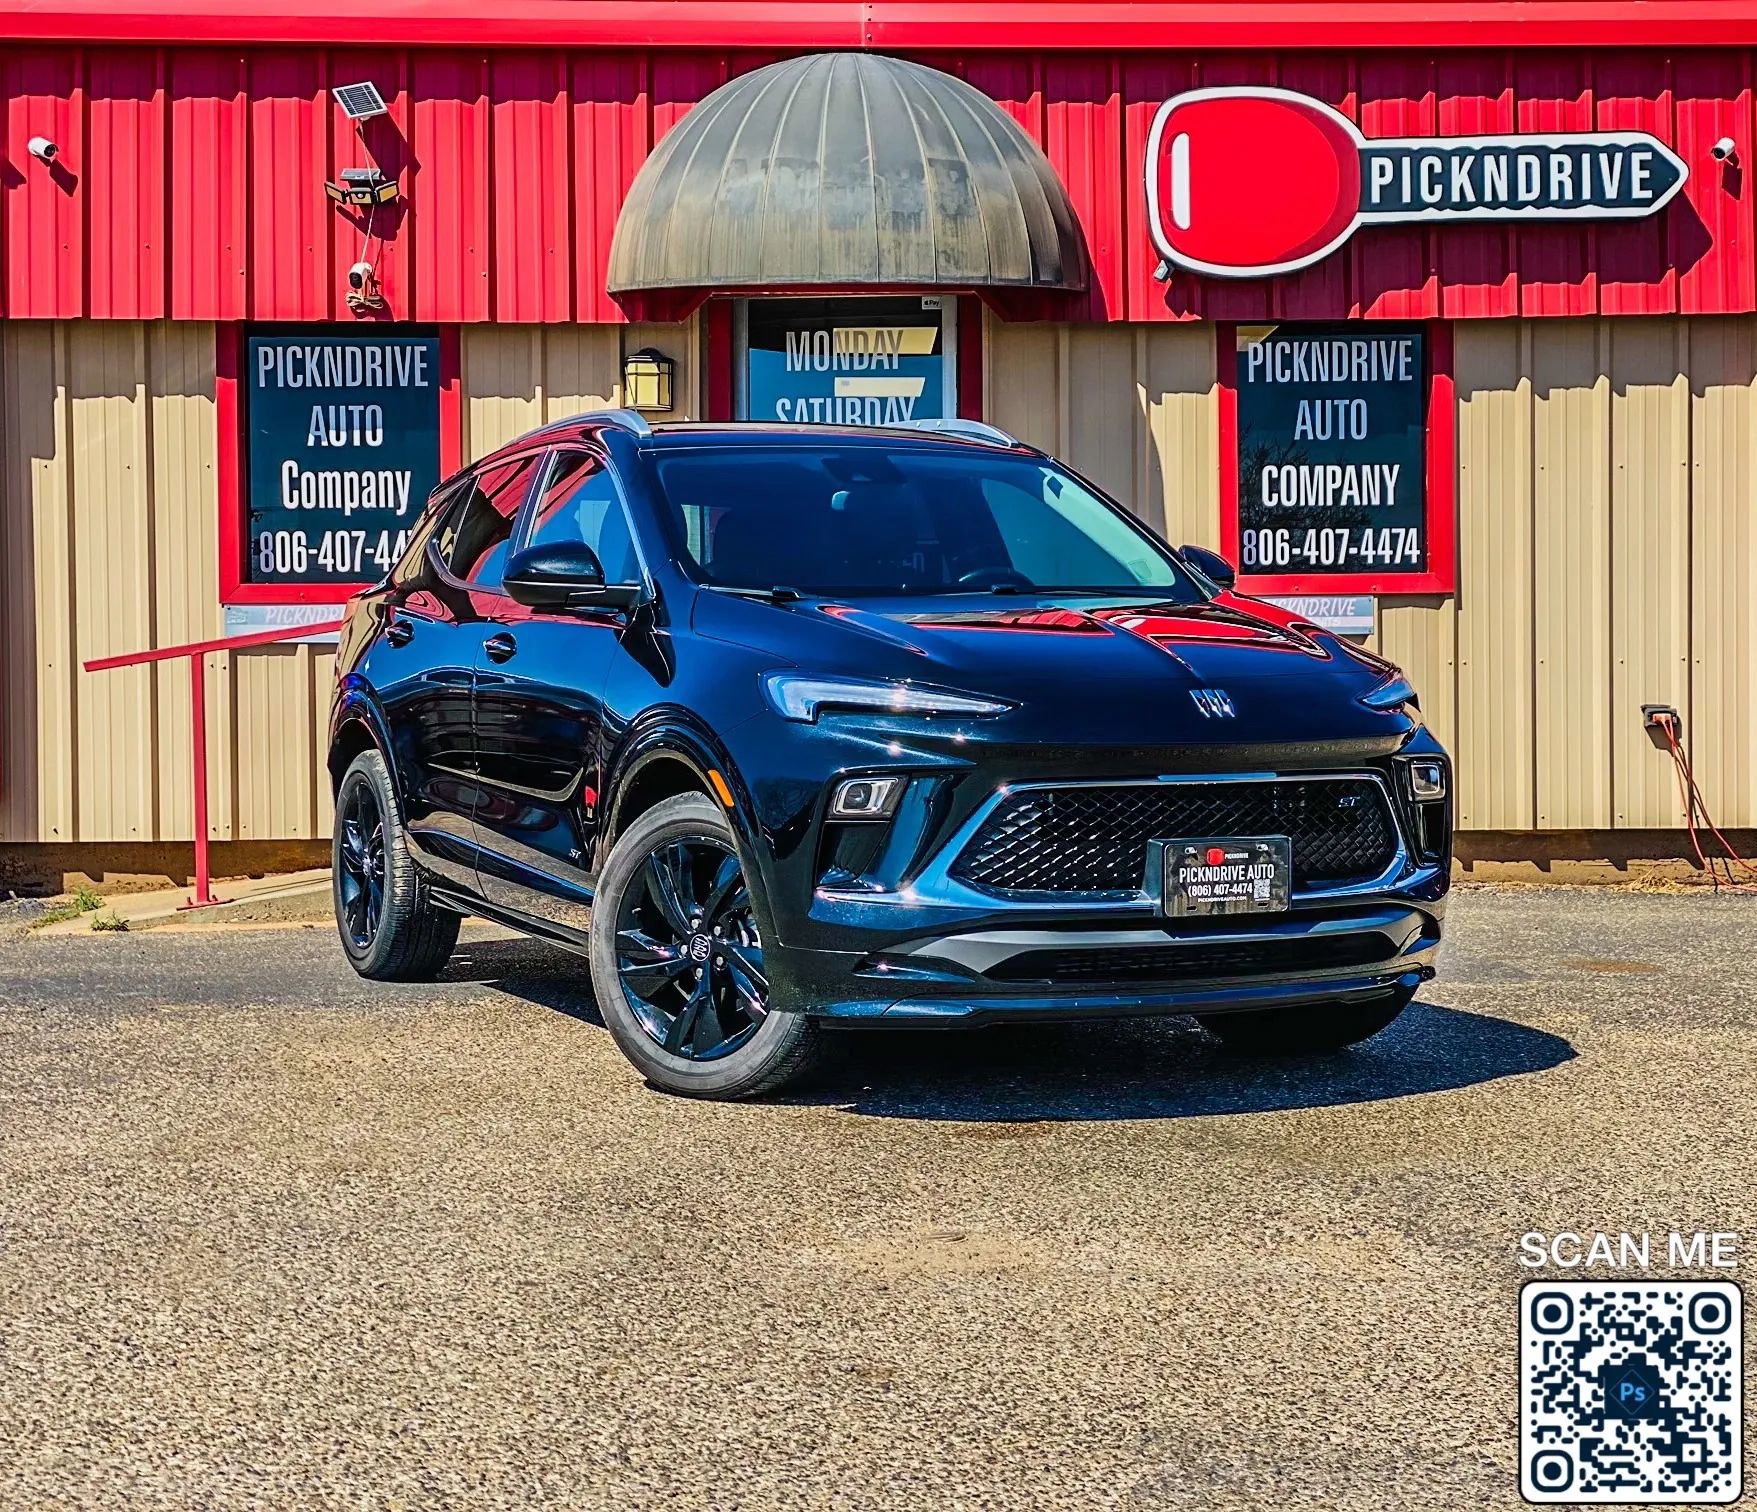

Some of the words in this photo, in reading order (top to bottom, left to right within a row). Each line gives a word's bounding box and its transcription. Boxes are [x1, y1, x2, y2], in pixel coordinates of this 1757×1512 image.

[1370, 151, 1653, 204] PICKNDRIVE
[257, 345, 429, 388] PICKNDRIVE
[785, 329, 904, 372] MONDAY
[1248, 340, 1413, 383] PICKNDRIVE
[306, 404, 384, 448] AUTO
[775, 395, 916, 426] SATURDAY
[1294, 398, 1368, 441] AUTO
[281, 459, 412, 517] Company
[1261, 463, 1401, 508] COMPANY
[259, 529, 413, 574] 806-407-44
[1242, 527, 1421, 566] 806-407-4474
[1179, 866, 1246, 883] PICKNDRIVE
[1247, 863, 1275, 880] AUTO
[1188, 884, 1212, 898] (806)
[1213, 883, 1253, 896] 407-4474
